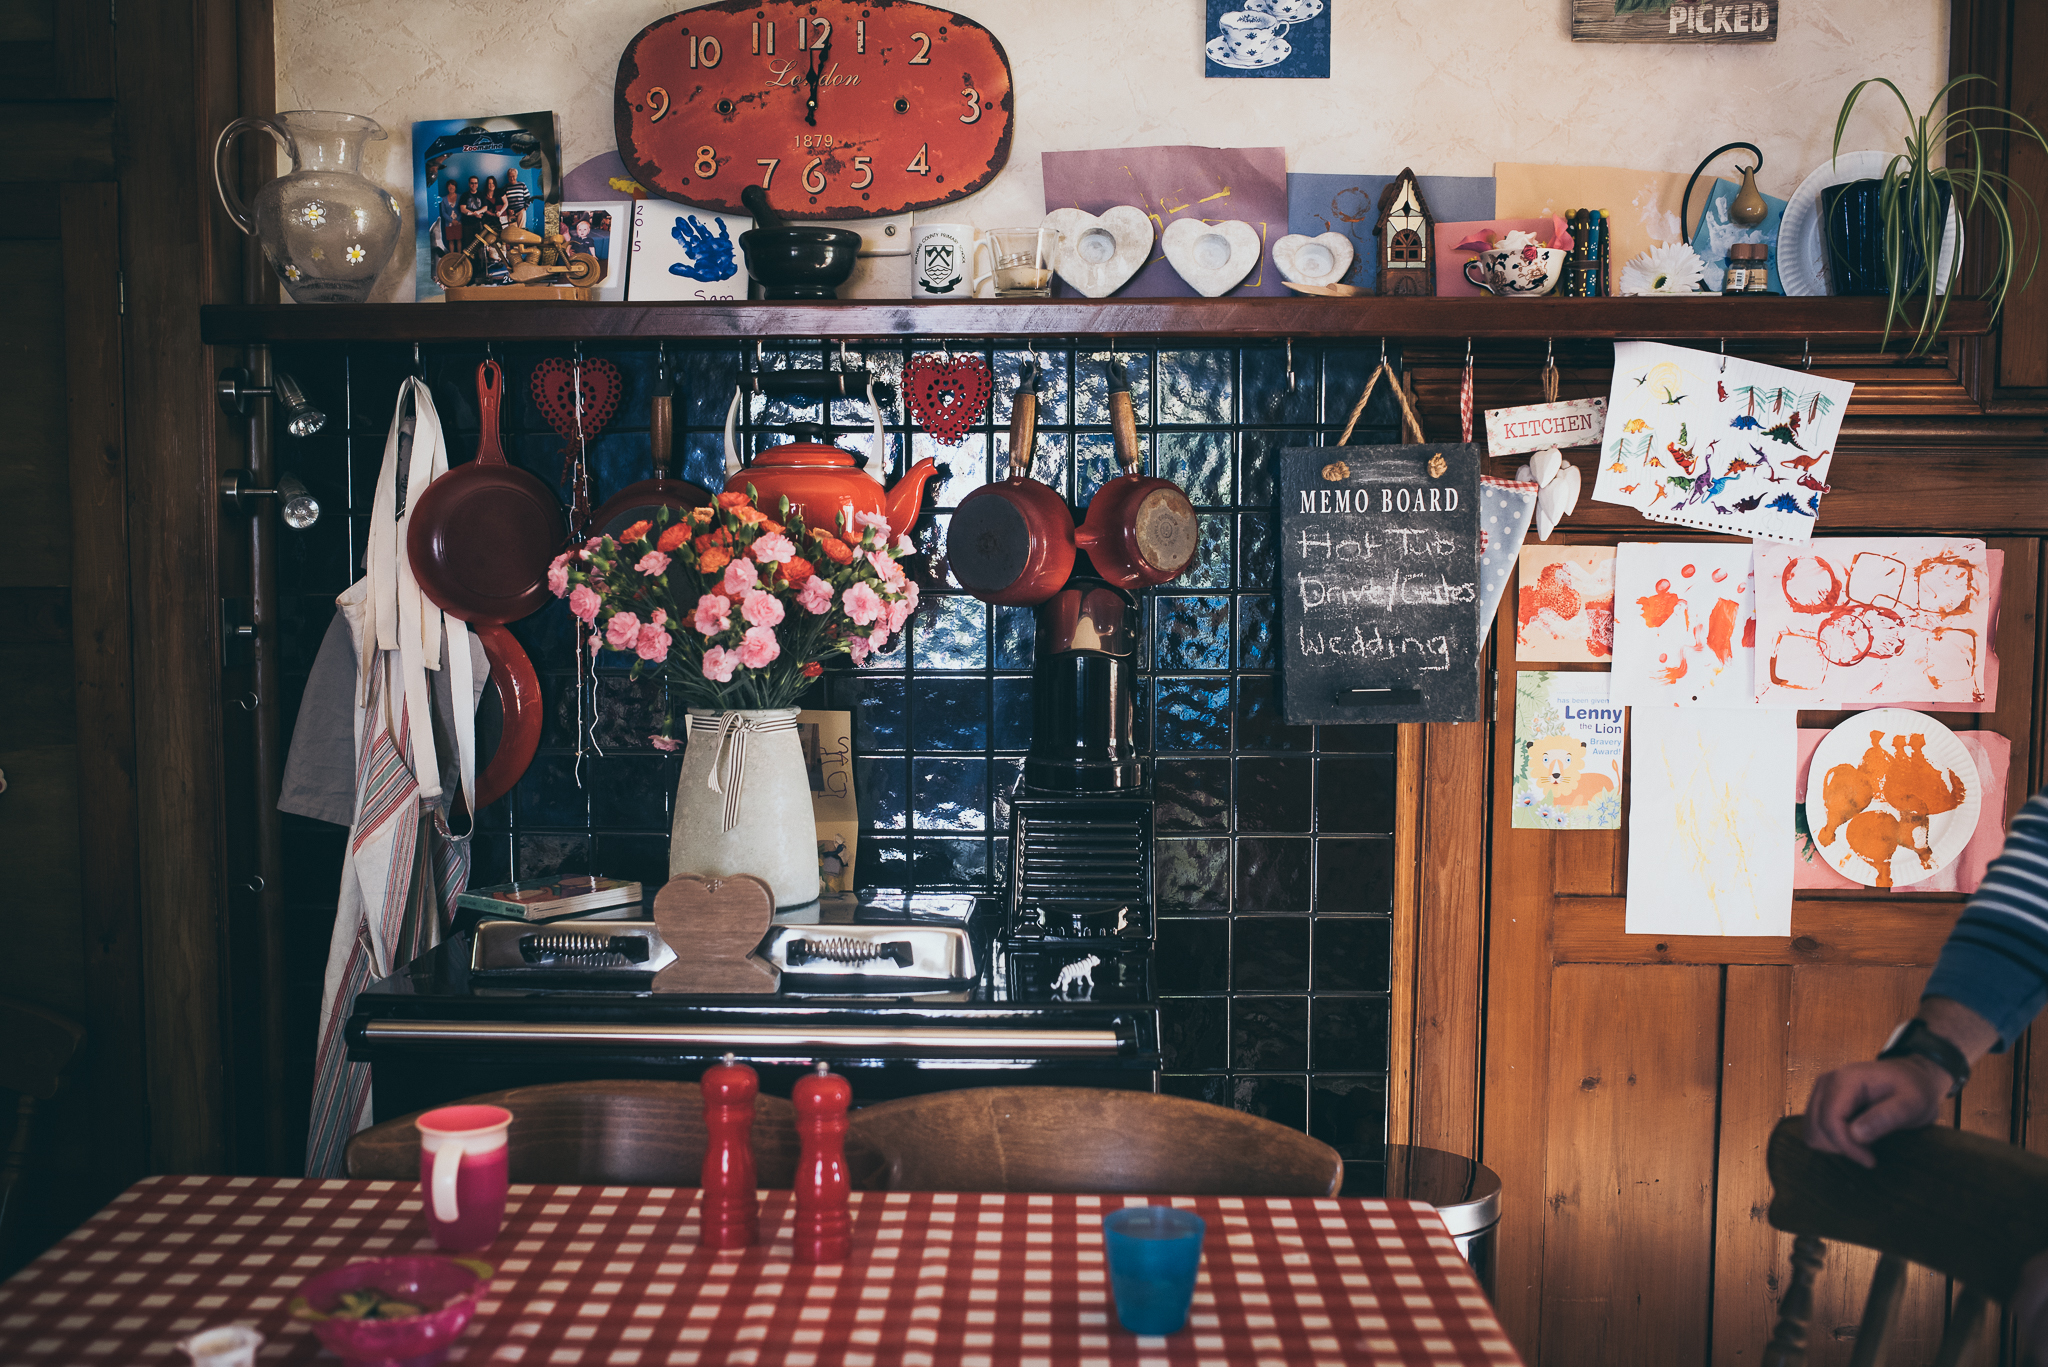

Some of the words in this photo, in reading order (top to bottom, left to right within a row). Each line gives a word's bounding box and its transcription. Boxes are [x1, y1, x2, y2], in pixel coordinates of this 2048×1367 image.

[798, 17, 832, 51] 12
[1668, 2, 1769, 34] PICKED
[689, 35, 722, 69] 10
[751, 21, 775, 55] 11
[856, 20, 866, 54] 1
[908, 32, 932, 65] 2
[765, 58, 861, 87] Lodon
[646, 86, 670, 123] 9
[958, 87, 982, 124] 3
[794, 134, 834, 148] 1879
[694, 145, 718, 178] 8
[756, 158, 781, 191] 7
[801, 157, 827, 195] 6
[850, 156, 874, 190] 5
[906, 143, 931, 176] 4
[1503, 413, 1593, 440] KITCHEN
[1299, 488, 1369, 514] MEMO
[1381, 487, 1459, 513] BOARD
[1297, 529, 1381, 562] Hot
[1382, 527, 1455, 556] Tub
[1297, 625, 1450, 671] Wedding
[1565, 705, 1622, 723] Lenny
[1590, 697, 1610, 705] given
[1590, 738, 1622, 747] Bravery
[1595, 723, 1622, 734] Lion
